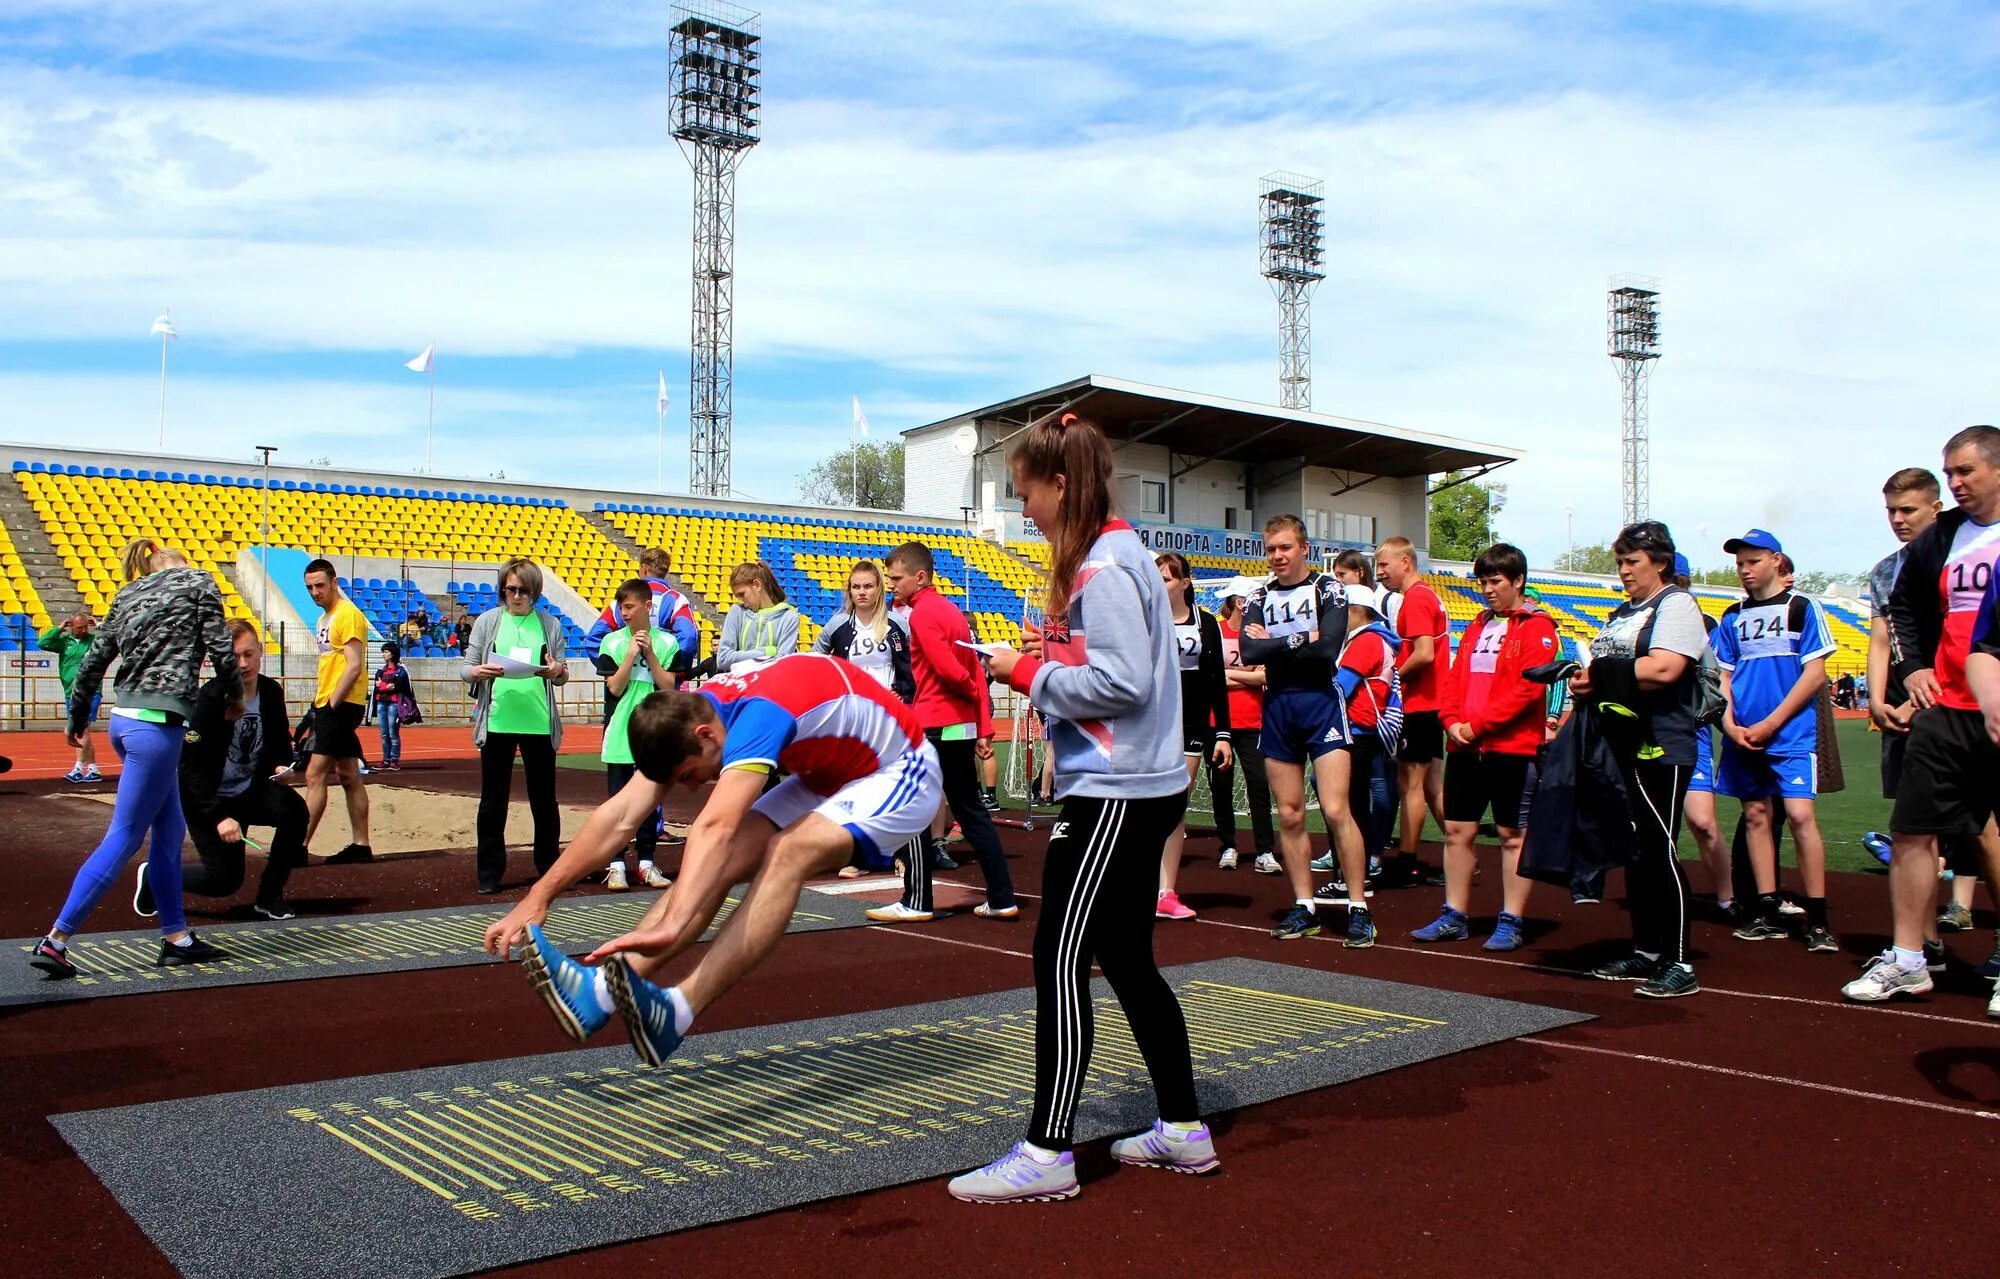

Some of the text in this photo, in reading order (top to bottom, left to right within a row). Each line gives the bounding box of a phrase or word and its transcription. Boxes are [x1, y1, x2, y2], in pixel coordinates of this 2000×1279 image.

[1155, 531, 1210, 553] СПОРТА
[1265, 598, 1313, 627] 114
[1738, 616, 1784, 642] 124
